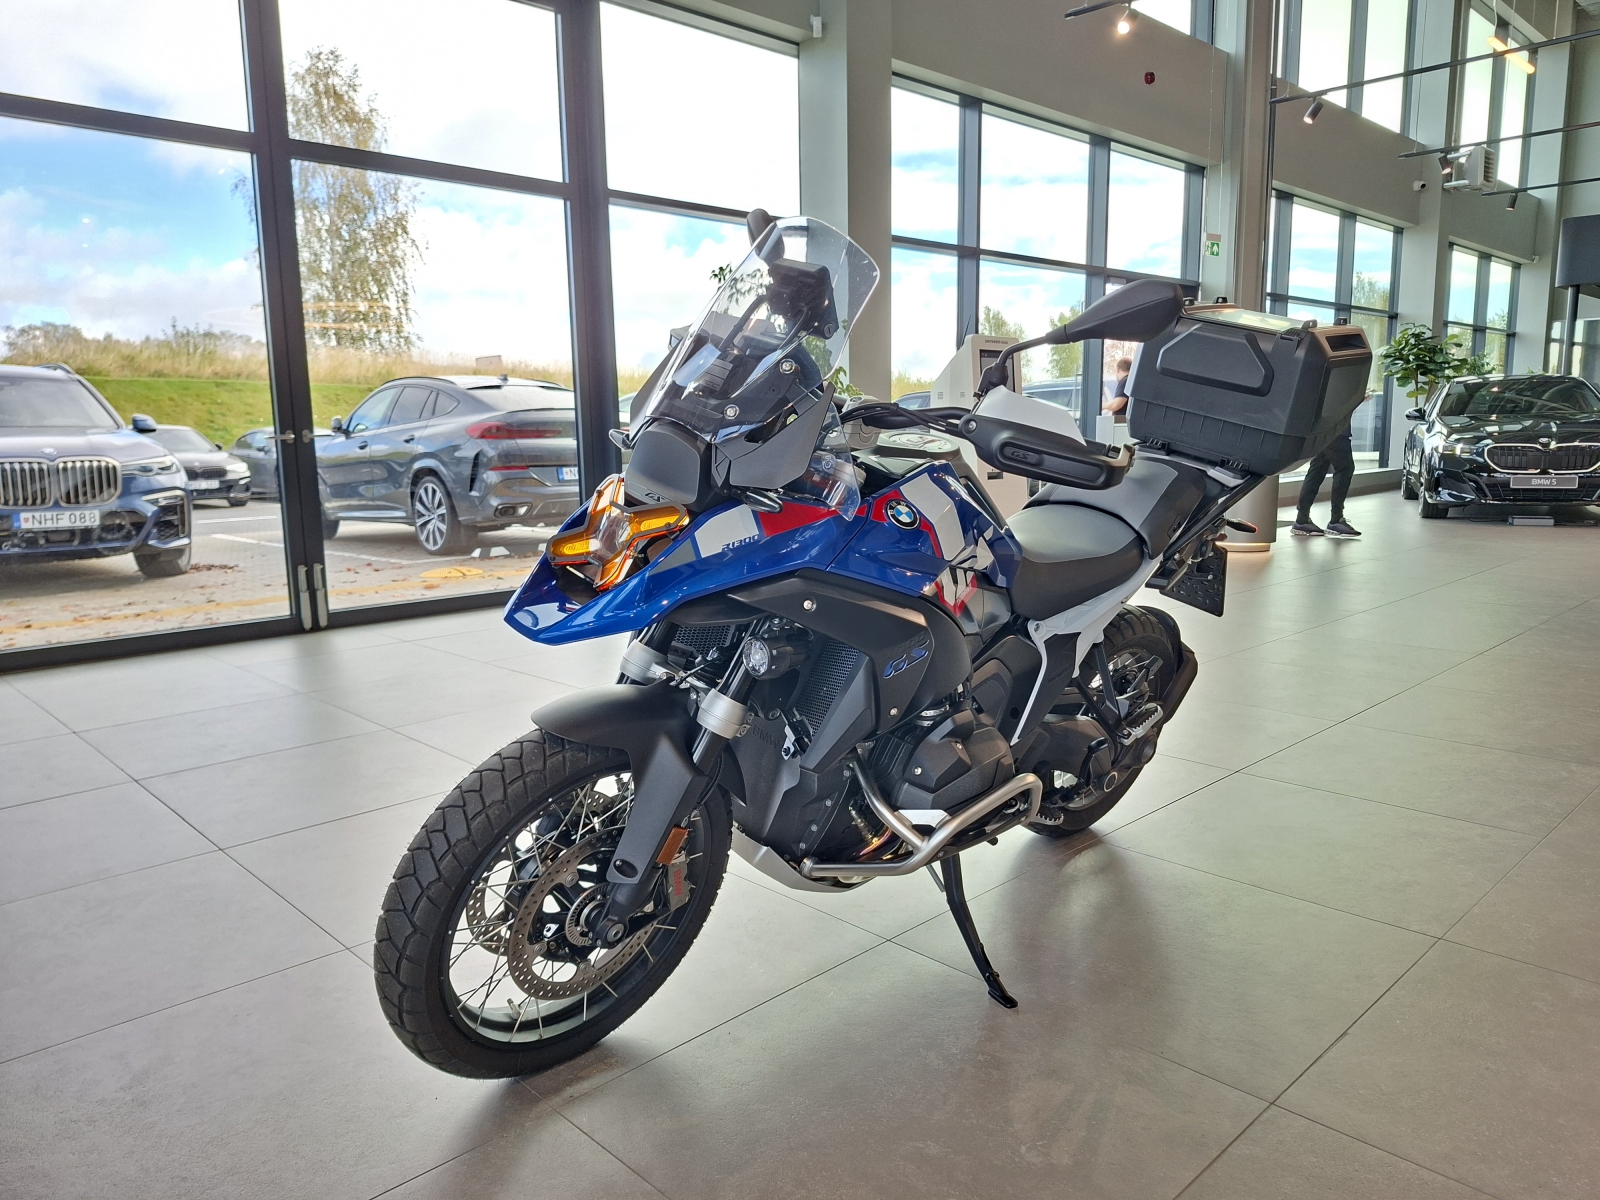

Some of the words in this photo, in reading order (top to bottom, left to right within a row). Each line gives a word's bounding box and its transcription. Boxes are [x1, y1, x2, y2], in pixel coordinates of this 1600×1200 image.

[1531, 478, 1551, 486] BMW
[1551, 478, 1557, 486] 5
[31, 513, 66, 526] NHF
[68, 511, 97, 525] 088
[673, 868, 684, 897] BMW
